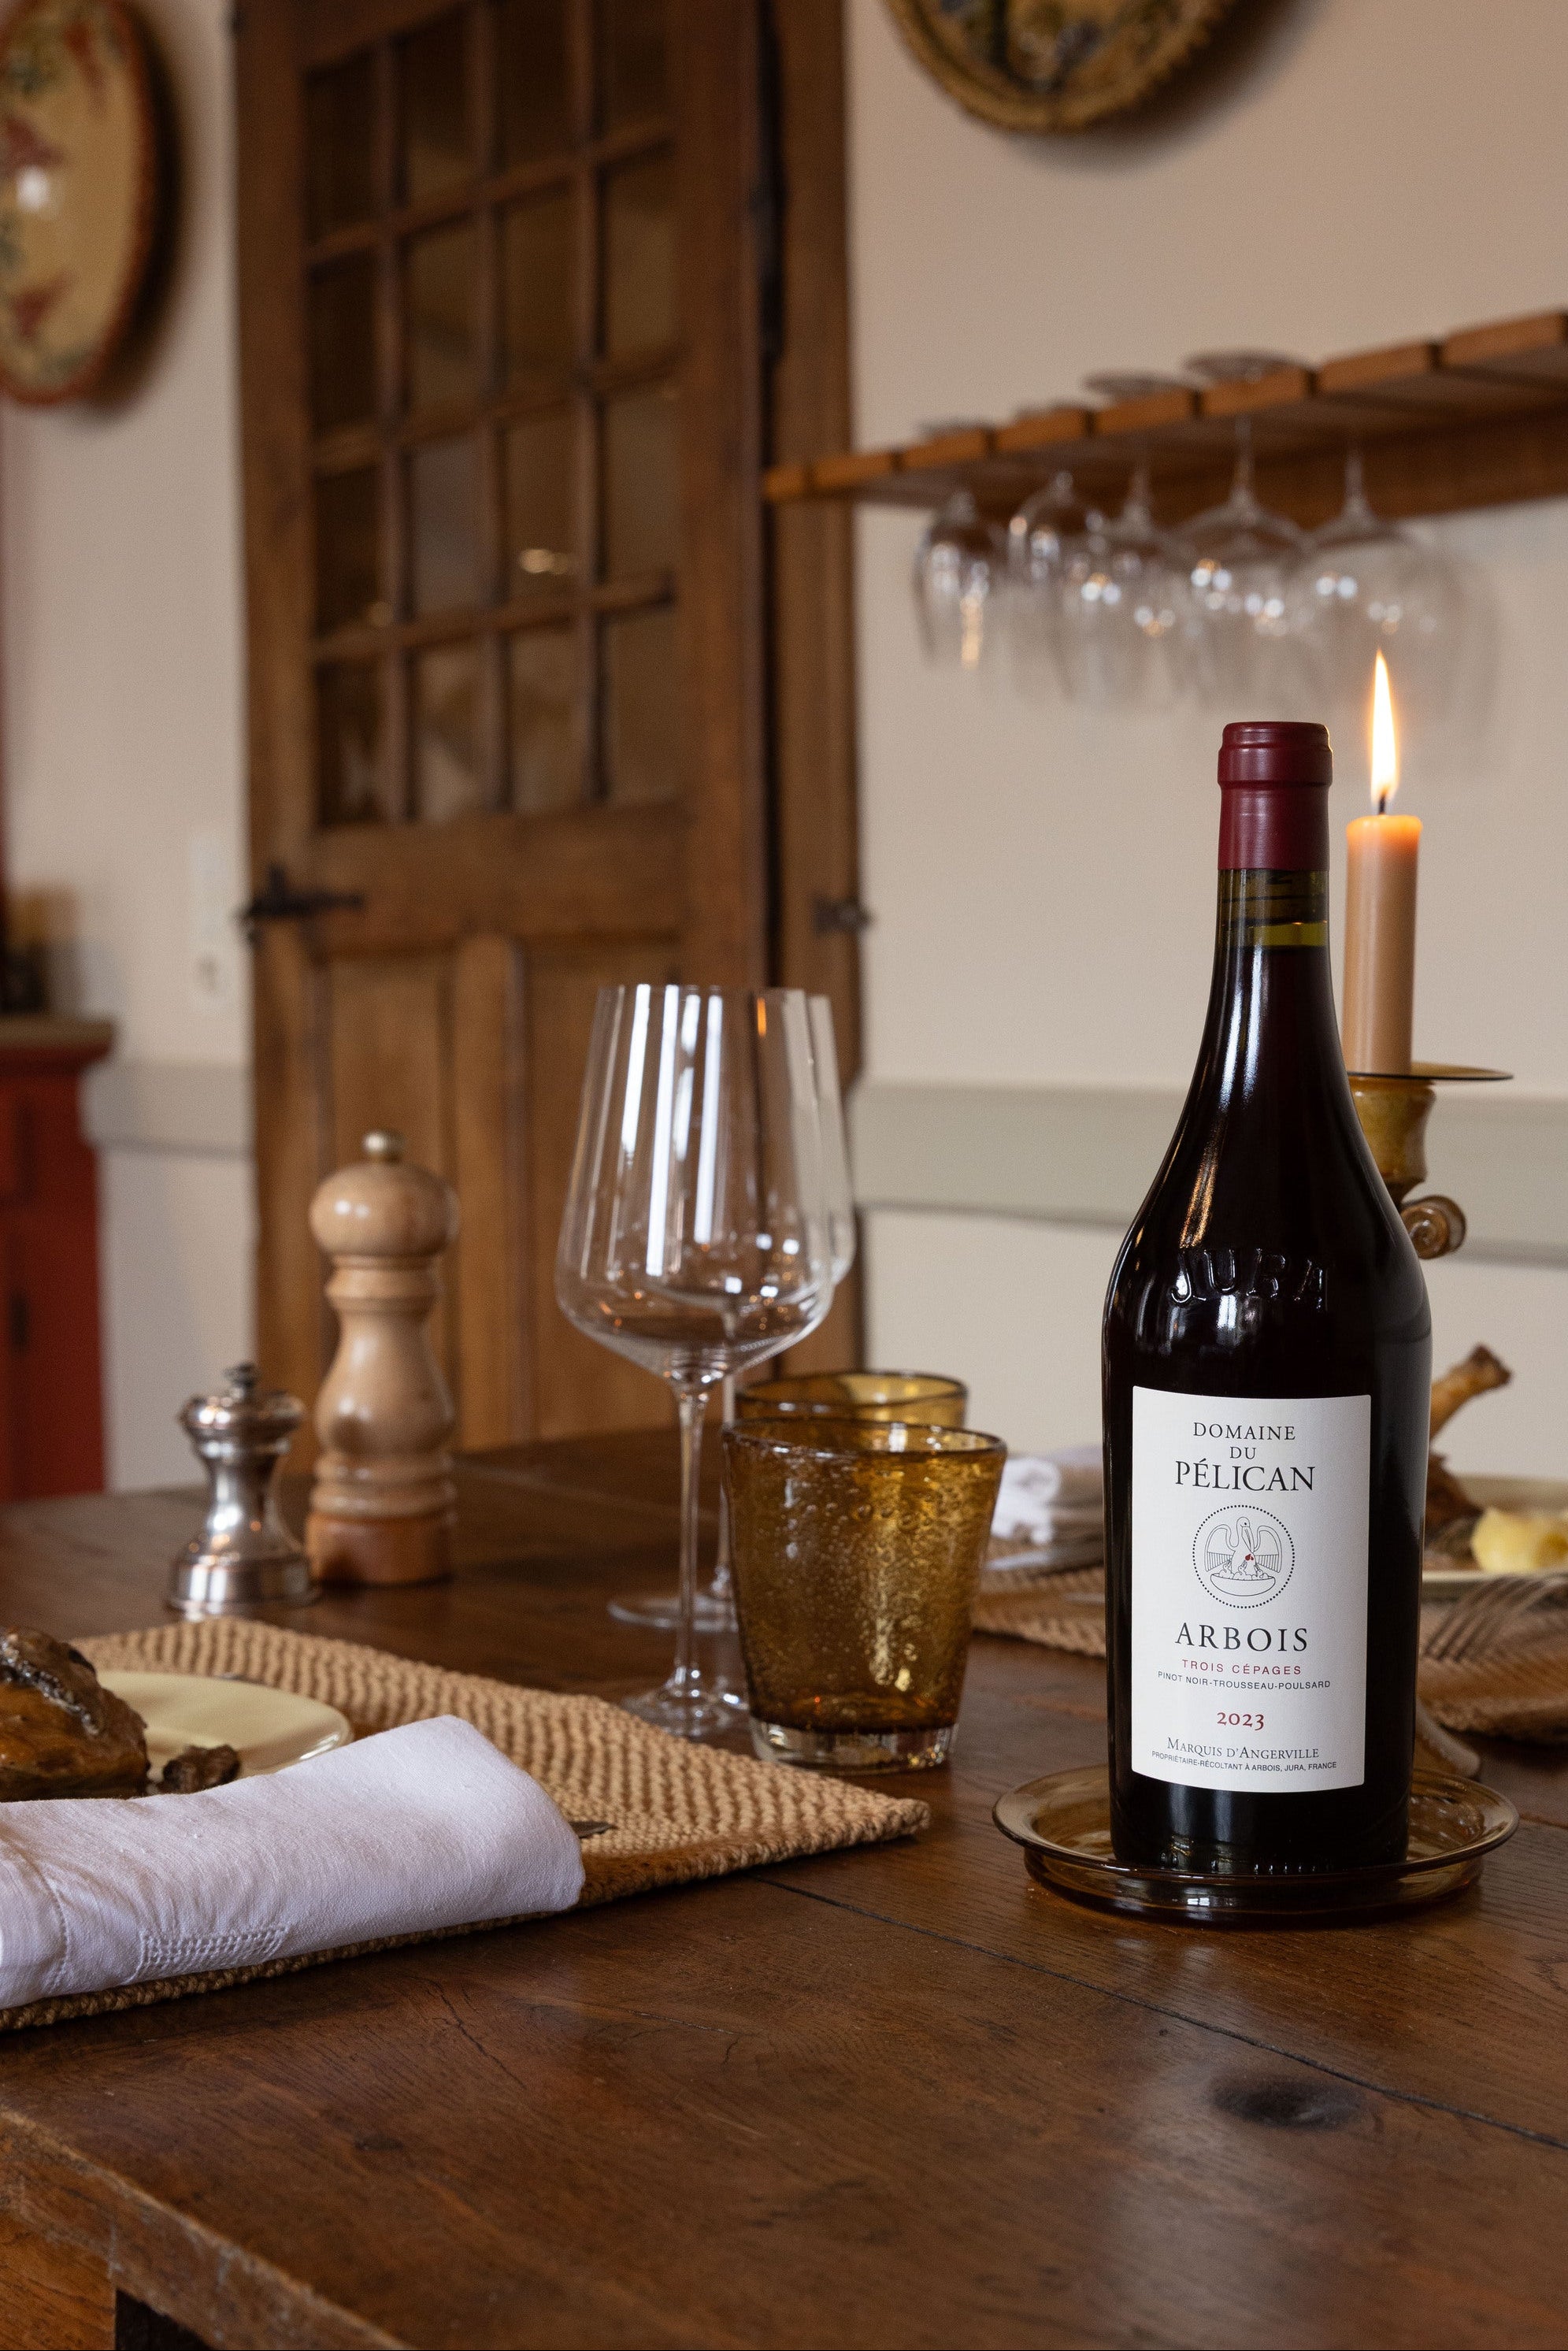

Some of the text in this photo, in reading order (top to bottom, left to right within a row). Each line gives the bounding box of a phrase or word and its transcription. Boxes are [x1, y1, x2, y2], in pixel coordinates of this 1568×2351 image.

[1192, 1422, 1296, 1441] DOMAINE
[1229, 1446, 1256, 1459] DU
[1175, 1458, 1315, 1491] PÉLICAN
[1174, 1622, 1308, 1652] ARBOIS
[1182, 1659, 1302, 1675] TROIS CÉPAGES
[1158, 1671, 1331, 1690] PINOT NOIR-TROUSSEAU-POULSARD
[1217, 1711, 1265, 1731] 2023
[1166, 1737, 1222, 1757] MARQUIS
[1151, 1751, 1243, 1771] PROPRIÉTAIRE-RÉCOLTANT
[1251, 1763, 1283, 1772] ARBOIS,
[1284, 1763, 1307, 1772] JURA,
[1308, 1761, 1337, 1770] FRANCE
